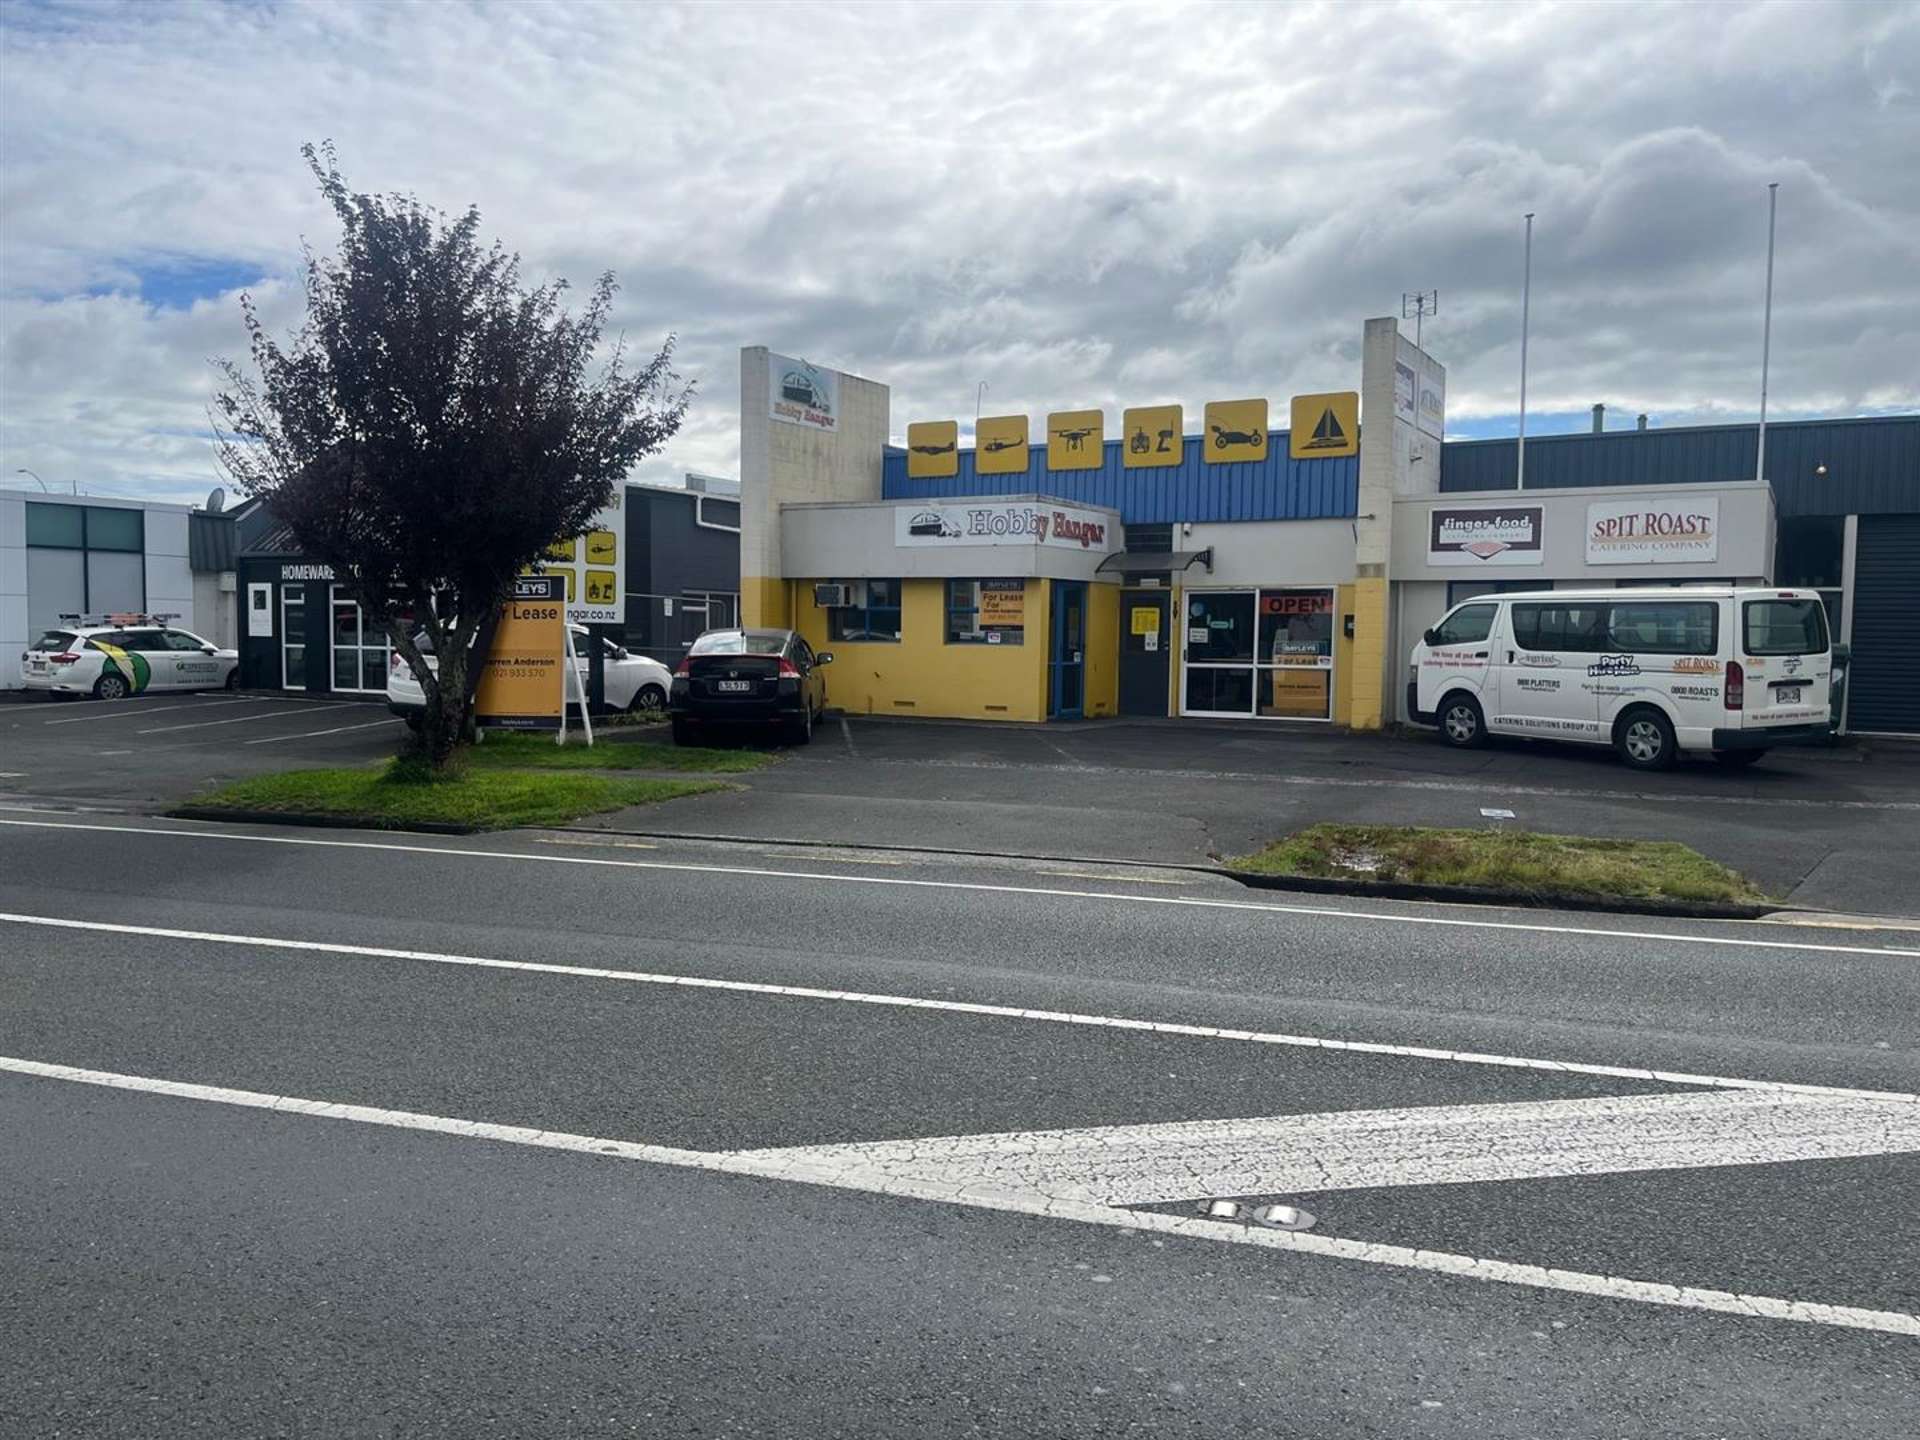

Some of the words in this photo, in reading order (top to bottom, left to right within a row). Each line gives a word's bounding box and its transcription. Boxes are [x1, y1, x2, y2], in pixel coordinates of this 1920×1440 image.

[774, 402, 802, 421] Hobby
[804, 410, 835, 427] Hangar
[967, 508, 1049, 543] Hobby
[1052, 511, 1104, 548] Hangar
[1444, 518, 1490, 533] finger
[1494, 515, 1530, 529] food
[1593, 513, 1639, 538] SPIT
[1644, 511, 1711, 536] ROAST
[1590, 542, 1648, 552] CATERING
[1651, 540, 1711, 551] COMPANY
[1269, 598, 1325, 613] OPEN
[512, 606, 558, 620] Lease
[513, 658, 555, 667] Anderson
[1600, 655, 1633, 667] Party
[1530, 679, 1561, 689] PLATTERS
[1687, 687, 1720, 697] ROASTS
[1494, 717, 1524, 726] CATERING
[1525, 718, 1560, 729] SOLUTIONS
[1562, 721, 1584, 730] GROUP
